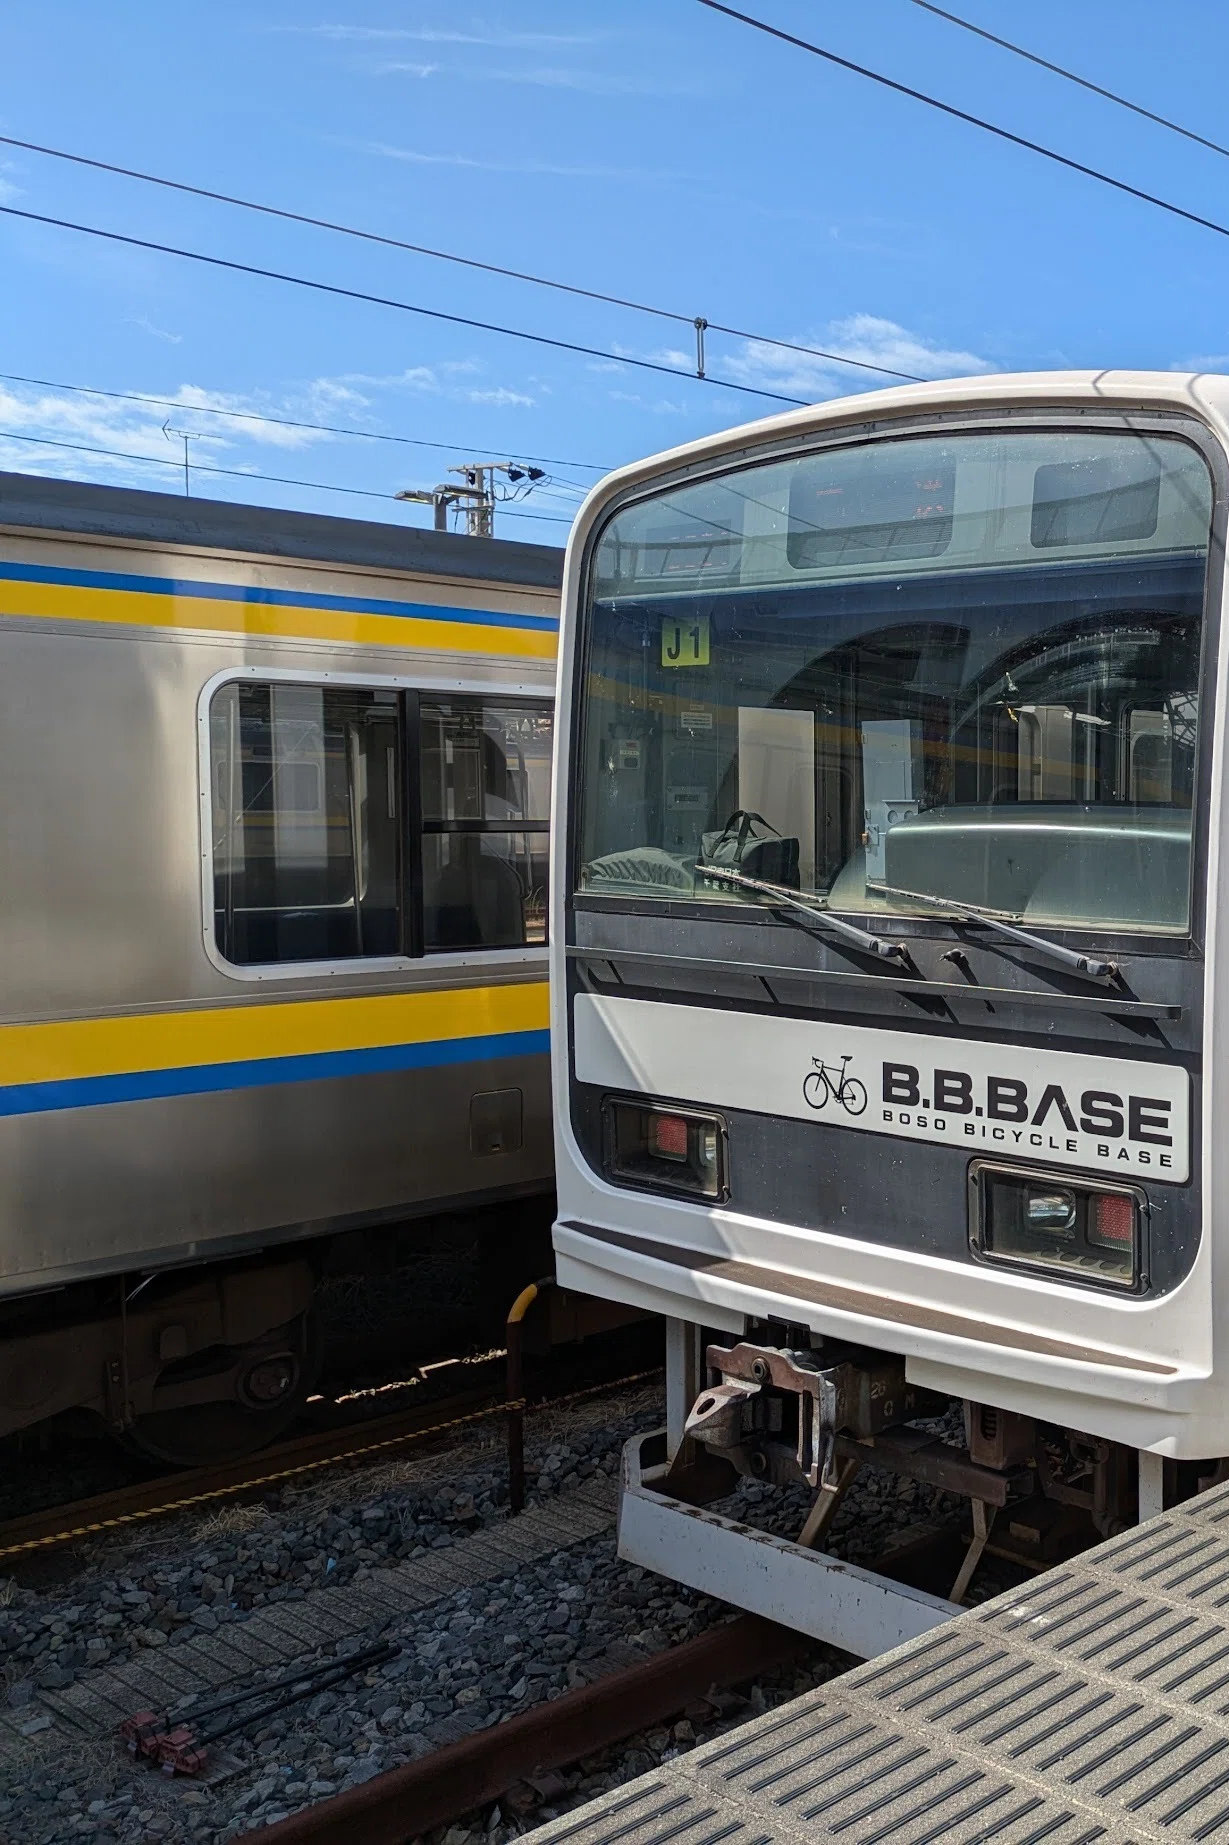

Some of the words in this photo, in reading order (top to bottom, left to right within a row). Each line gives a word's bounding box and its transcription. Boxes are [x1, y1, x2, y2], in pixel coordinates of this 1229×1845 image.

[882, 1109, 946, 1131] BOSO
[964, 1123, 1078, 1153] BICYCLE
[1097, 1144, 1172, 1168] BASE
